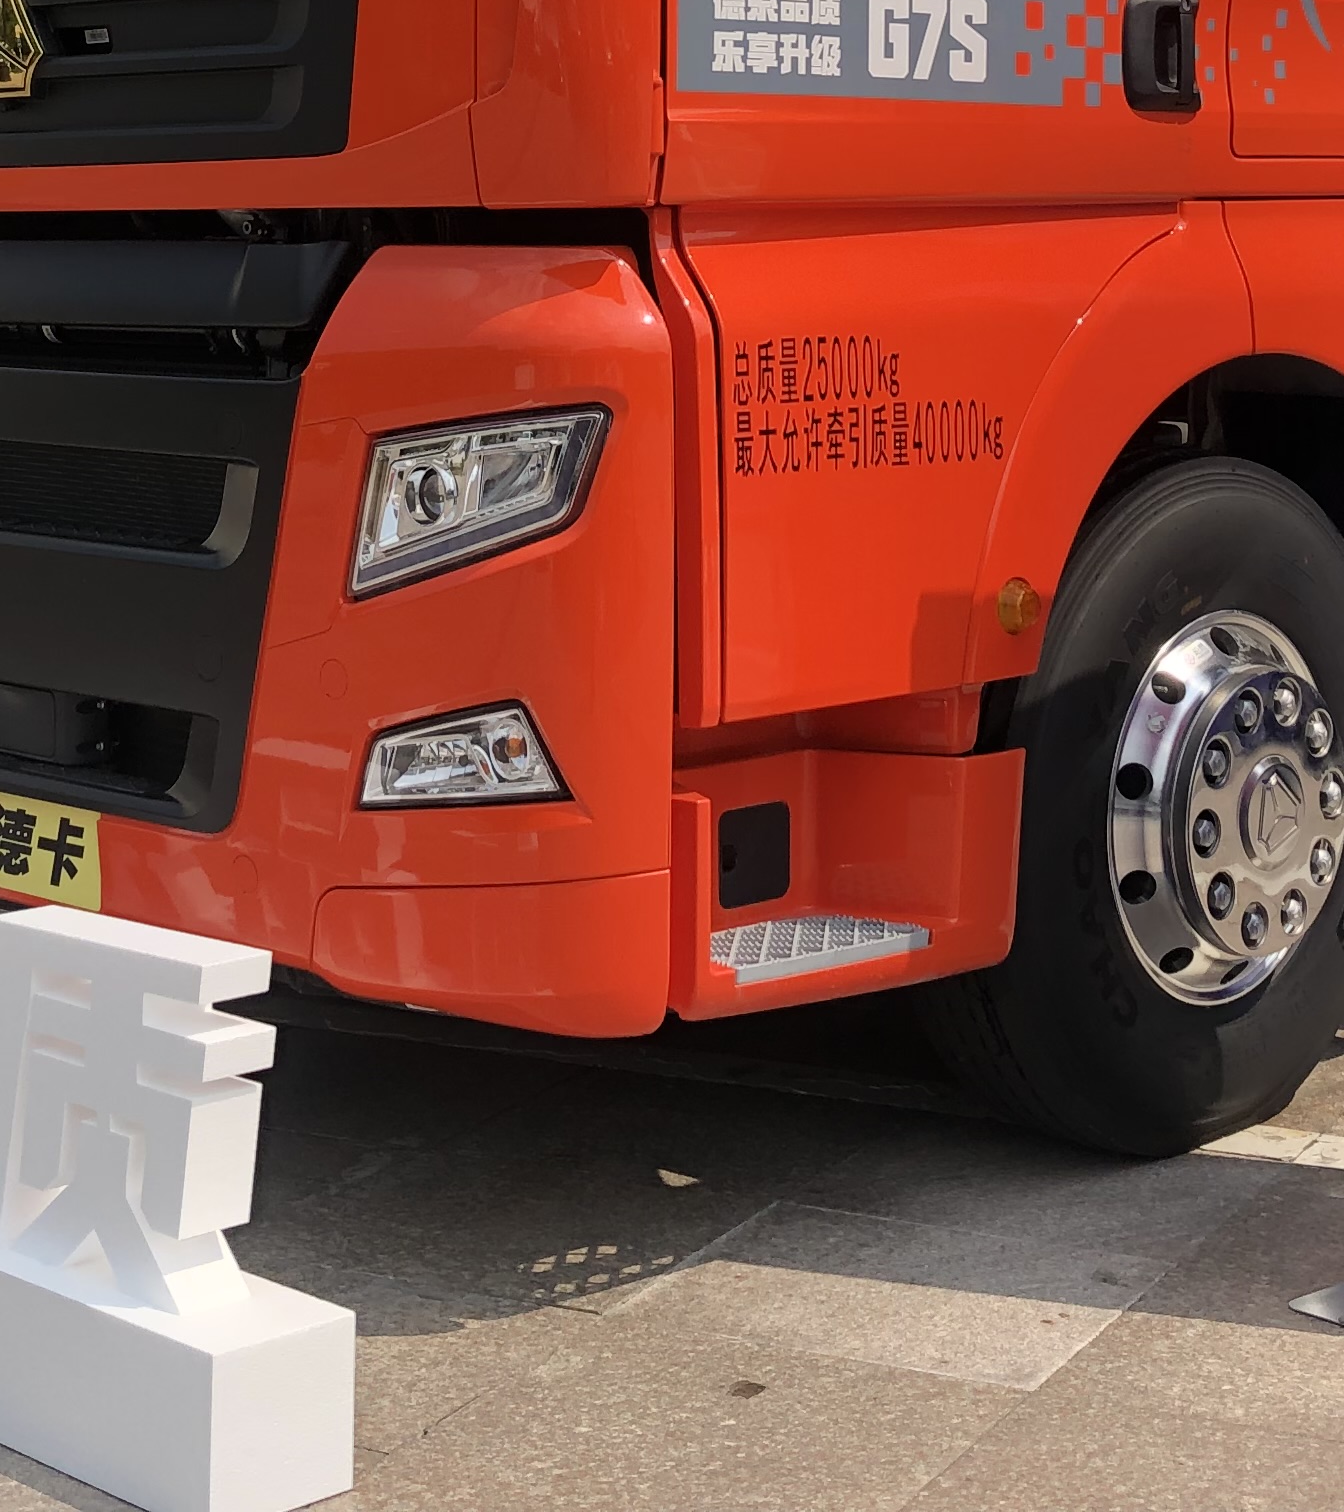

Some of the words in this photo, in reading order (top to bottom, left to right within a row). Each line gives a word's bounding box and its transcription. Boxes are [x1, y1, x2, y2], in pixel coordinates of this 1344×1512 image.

[711, 30, 842, 77] 乐享升级
[733, 335, 901, 406] 总质量25000kg
[734, 399, 1004, 477] 最大允许牵引质量40000kg
